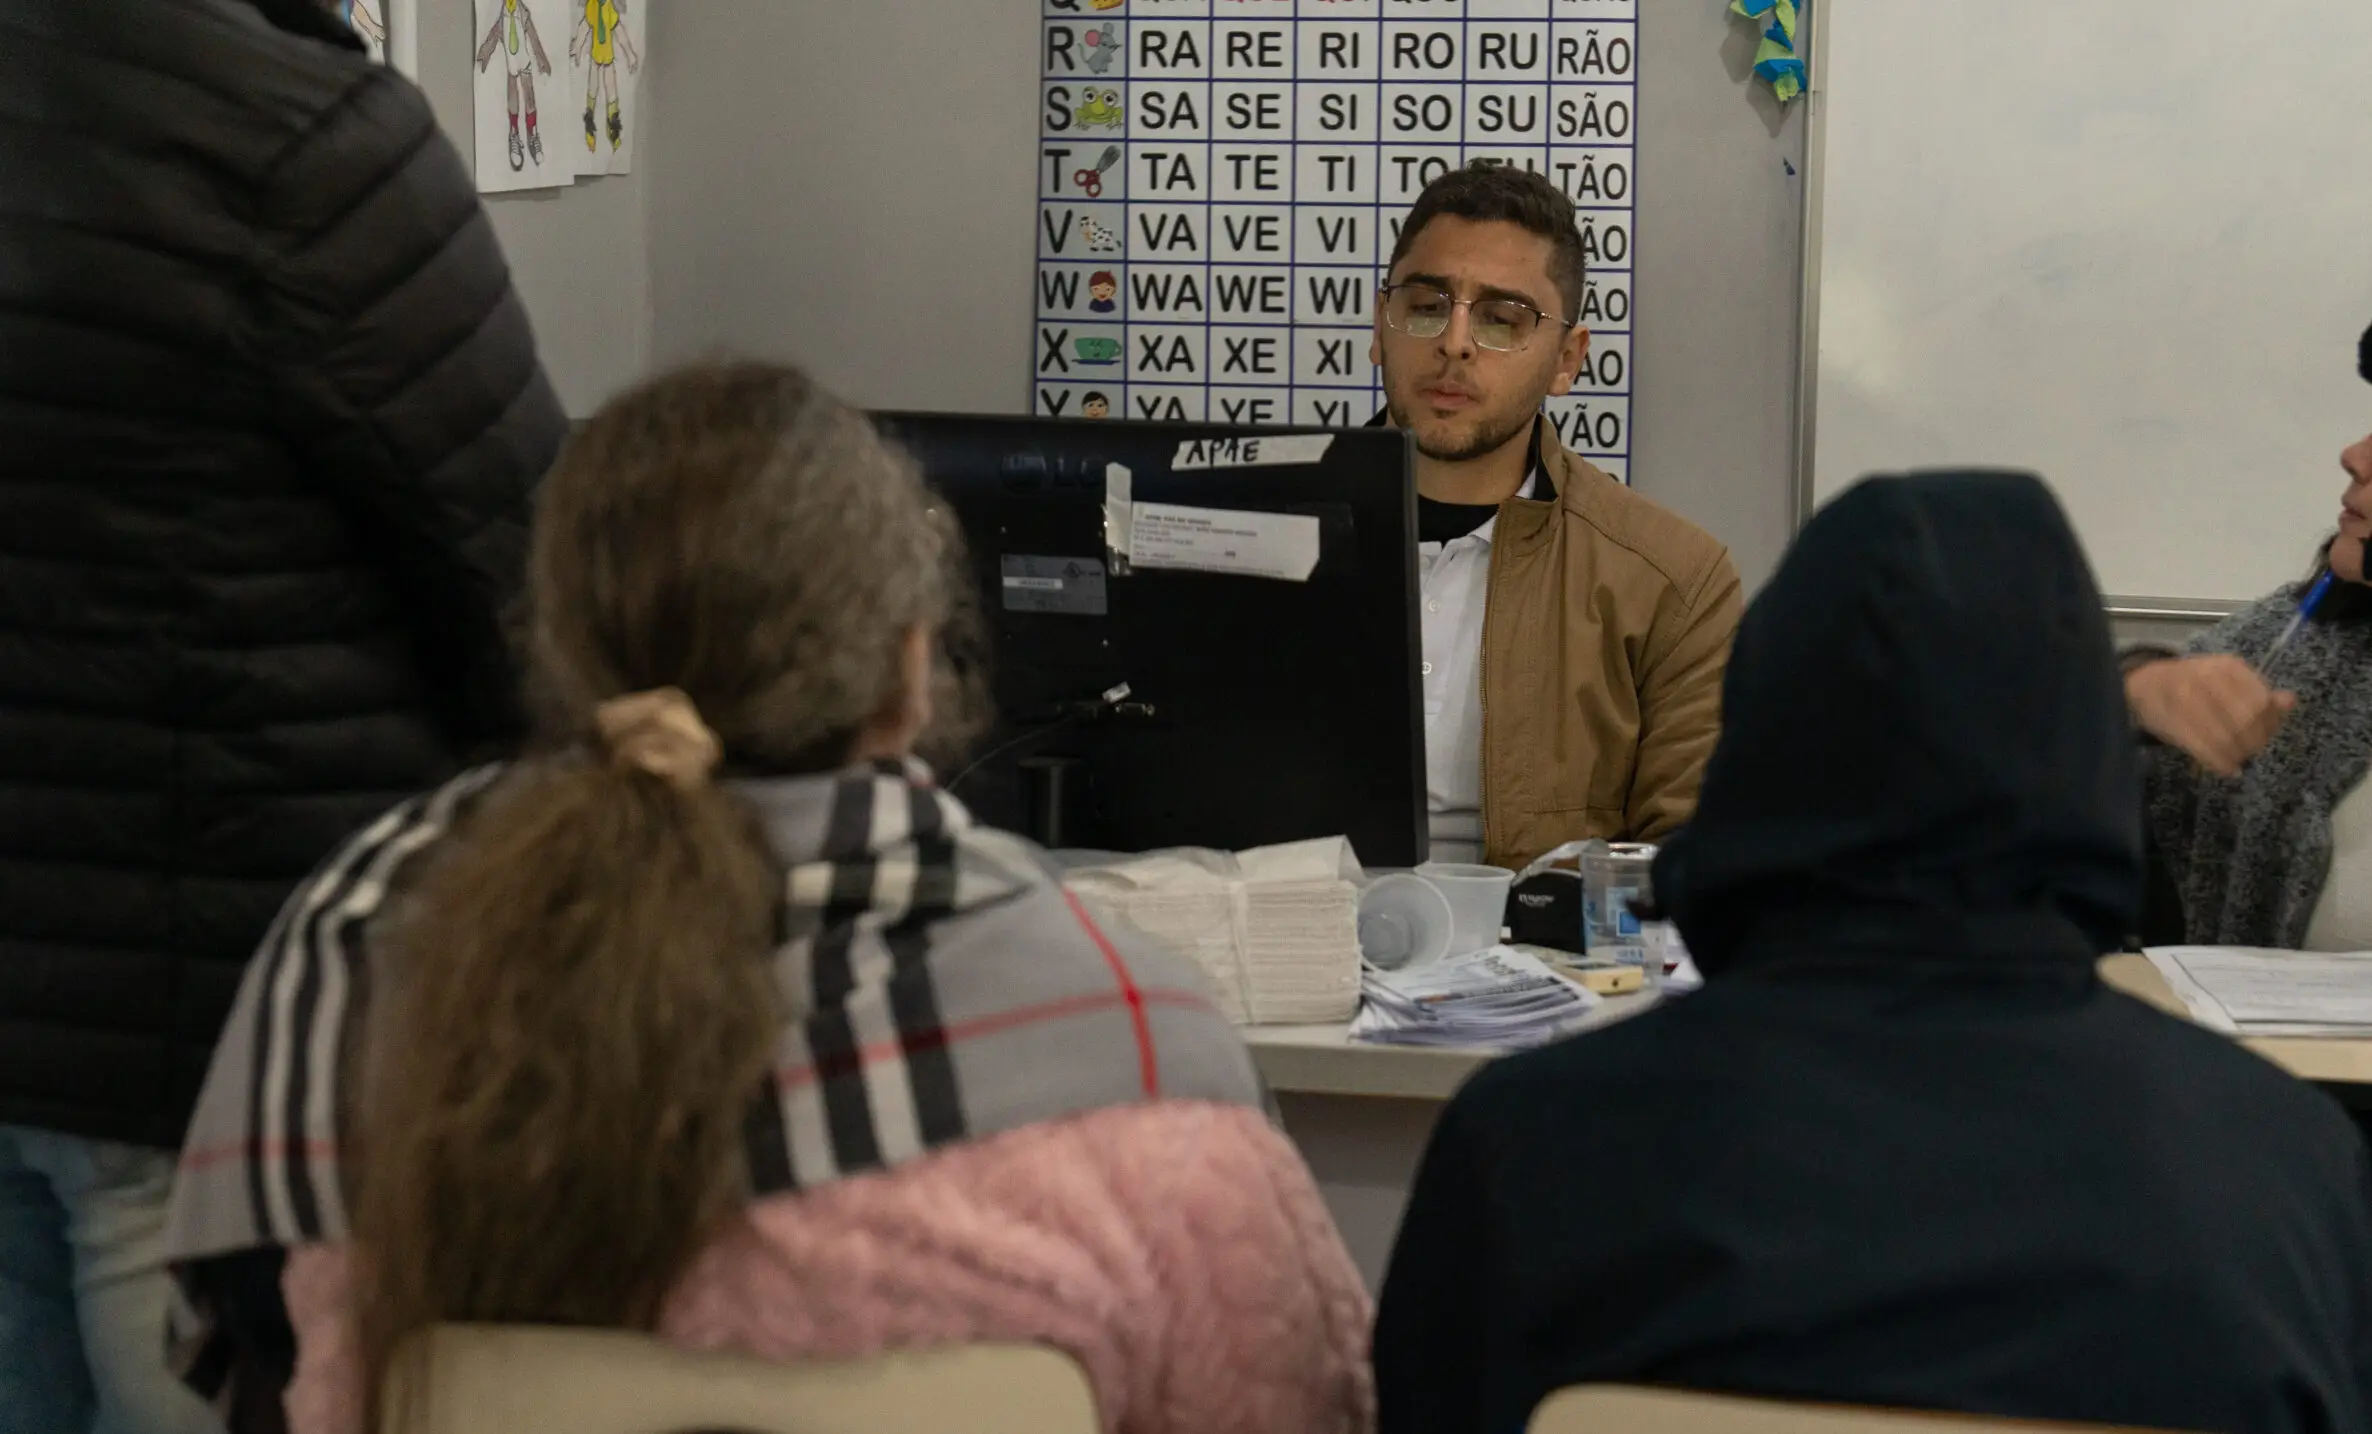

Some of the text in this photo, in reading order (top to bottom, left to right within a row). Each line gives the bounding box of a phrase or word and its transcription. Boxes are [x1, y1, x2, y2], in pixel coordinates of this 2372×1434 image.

[1046, 26, 1631, 75] R RA RE RI RO RU RÃO
[1045, 86, 1629, 138] S SA SE SI SO SU SÃO
[1044, 149, 1071, 194] T
[1140, 152, 1196, 191] TA
[1225, 154, 1279, 191] TE
[1318, 155, 1356, 193] TI
[1556, 154, 1628, 200] TÃO
[1043, 209, 1073, 254] V
[1138, 212, 1197, 252] VA
[1223, 214, 1280, 252] VE
[1316, 216, 1356, 254] VI
[1582, 216, 1628, 262] ÃO
[1041, 270, 1629, 322] W WA WE WI ÃO
[1041, 328, 1069, 374] X
[1138, 334, 1196, 374] XA
[1223, 337, 1277, 374] XE
[1315, 338, 1353, 376] XI
[1549, 402, 1620, 448] YÃO
